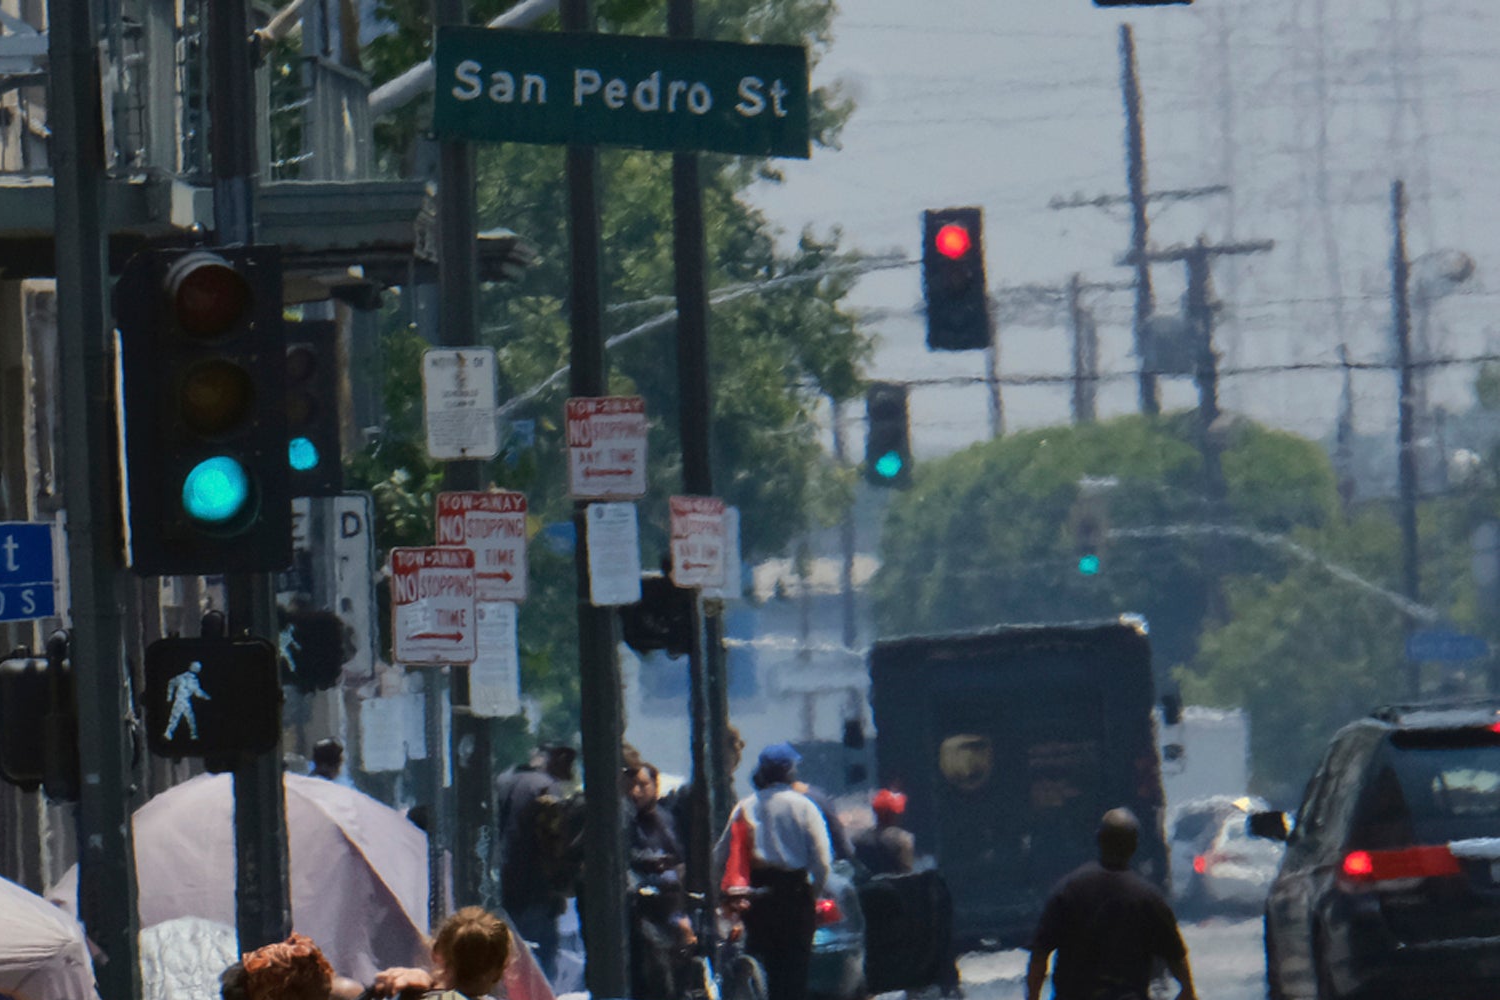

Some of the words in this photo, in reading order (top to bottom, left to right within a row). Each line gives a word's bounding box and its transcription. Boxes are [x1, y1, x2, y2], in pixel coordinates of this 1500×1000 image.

[451, 59, 547, 105] San
[573, 68, 713, 115] Pedro
[734, 76, 788, 118] St
[569, 420, 591, 445] NO
[441, 496, 523, 511] TOW-AWAY
[439, 515, 464, 543] NO
[396, 551, 469, 566] TOW-AWAY
[486, 549, 515, 566] TIME
[395, 574, 418, 601] NO
[420, 575, 473, 598] STOPPING
[21, 589, 36, 614] S
[436, 609, 466, 627] TIME
